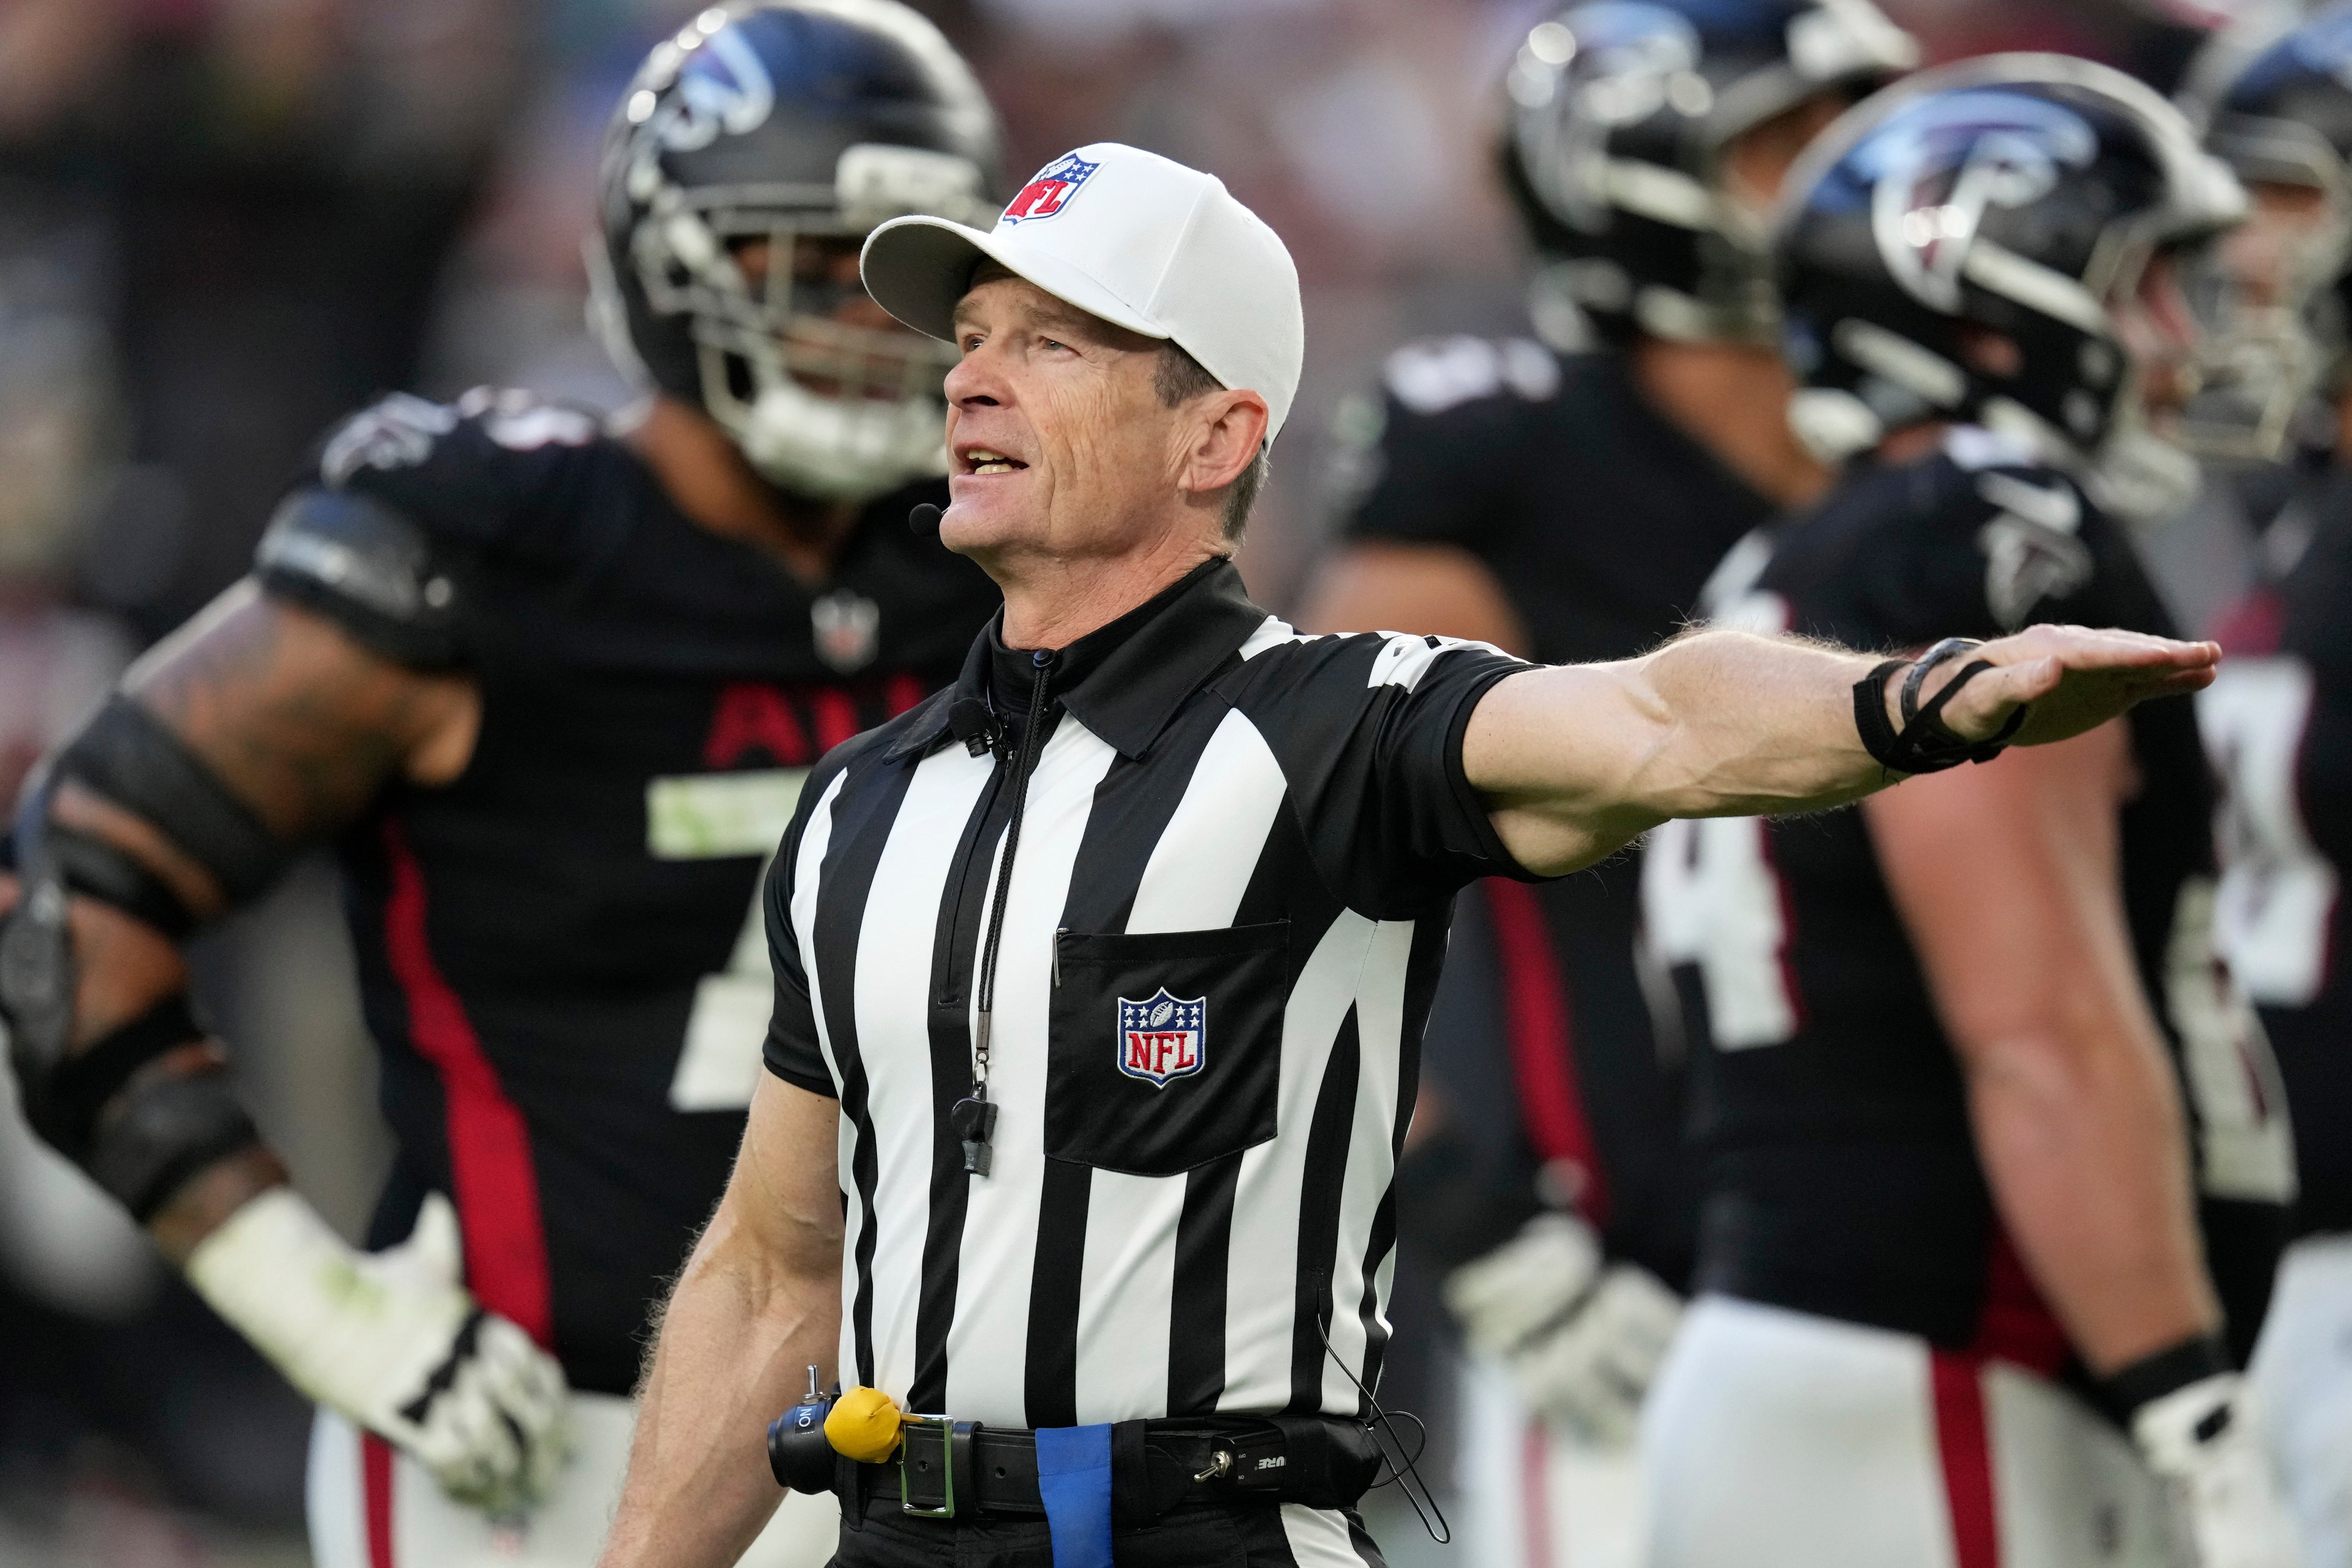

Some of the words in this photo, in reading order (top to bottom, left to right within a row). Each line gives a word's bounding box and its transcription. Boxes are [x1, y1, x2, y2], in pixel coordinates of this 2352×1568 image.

[1005, 180, 1069, 217] NFL
[1128, 1032, 1194, 1074] NFL
[799, 1408, 812, 1427] ON
[1258, 1456, 1286, 1469] URE
